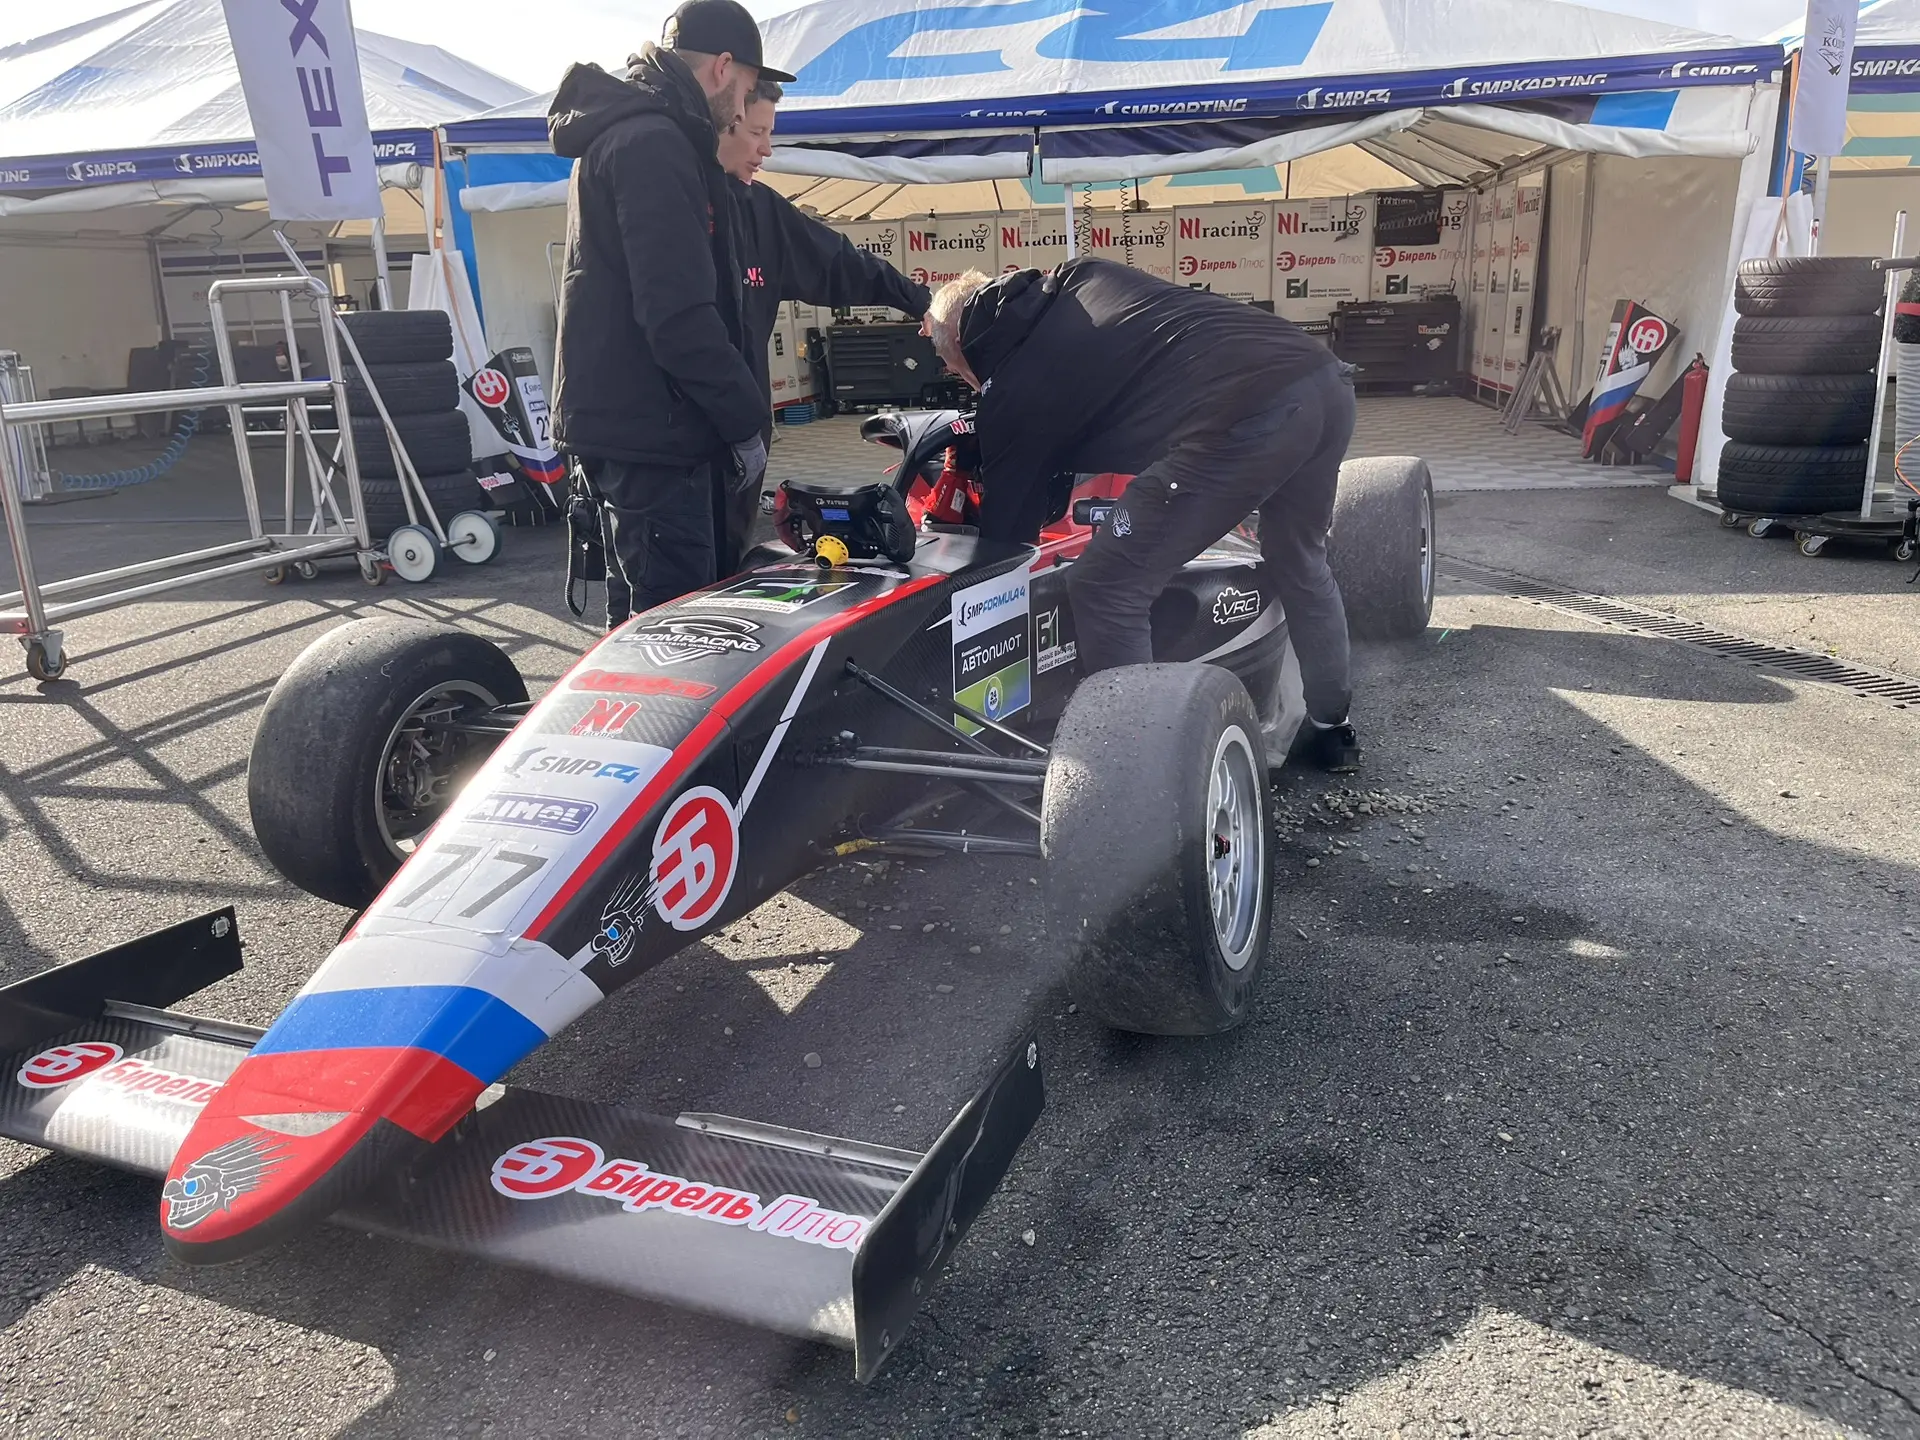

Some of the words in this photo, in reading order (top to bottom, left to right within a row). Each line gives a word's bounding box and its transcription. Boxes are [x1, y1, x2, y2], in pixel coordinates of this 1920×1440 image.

[1323, 88, 1391, 109] SMPF4
[1180, 217, 1260, 240] NIracing
[1278, 212, 1360, 236] NIring
[1200, 258, 1237, 270] Бирель
[1239, 257, 1266, 269] Плюс
[1298, 254, 1337, 268] Бирель
[1398, 250, 1437, 264] Бирель
[931, 271, 962, 284] Бирел
[1222, 597, 1257, 616] VRC
[620, 633, 761, 652] ZOOMRACING
[962, 633, 1022, 675] АВТОПИЛОТ
[531, 756, 641, 784] SMPF4
[476, 797, 580, 824] AIMOL
[394, 843, 549, 919] 77
[586, 1163, 755, 1220] Бирель
